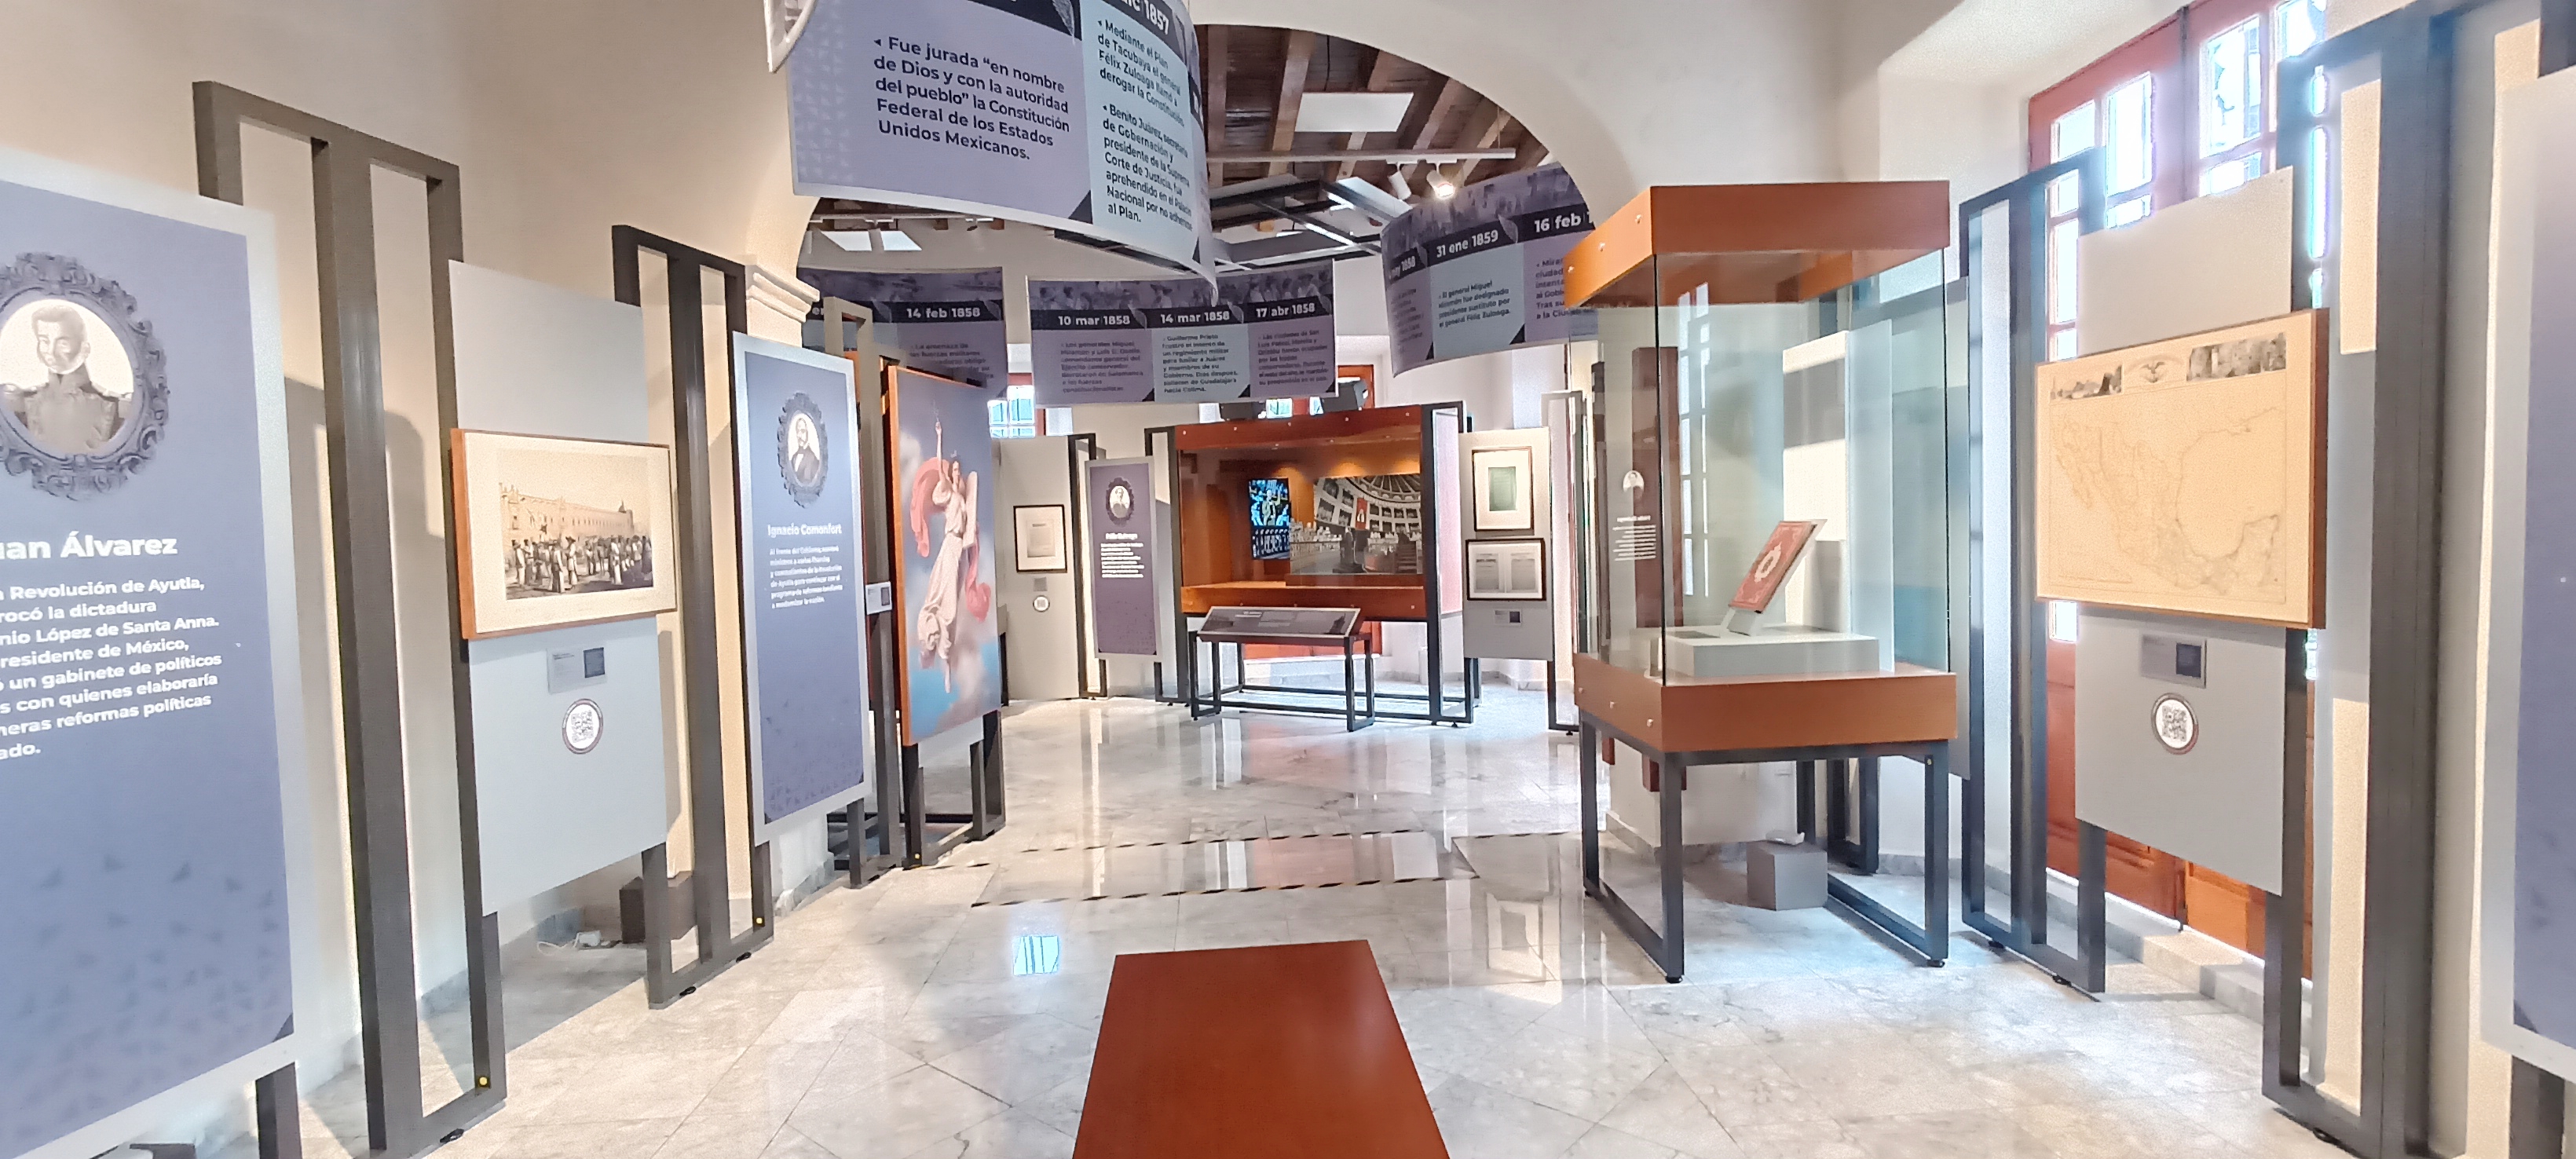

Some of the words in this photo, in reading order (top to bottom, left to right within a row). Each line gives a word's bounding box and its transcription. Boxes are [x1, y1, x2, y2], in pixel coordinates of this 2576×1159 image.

[1143, 0, 1169, 35] 1857
[1098, 33, 1111, 48] de
[1112, 39, 1151, 72] Tacubaya
[1105, 20, 1145, 53] Mediante
[888, 36, 921, 56] Fue
[925, 42, 979, 68] jurada
[982, 57, 1009, 76] “en
[1012, 68, 1065, 93] nombre
[1099, 49, 1121, 70] Félix
[1123, 62, 1154, 90] Zuloaga
[873, 55, 897, 71] de
[902, 60, 939, 79] Dios
[942, 71, 953, 85] y
[957, 75, 986, 90] con
[990, 79, 1002, 93] la
[1006, 86, 1068, 114] autoridad
[1100, 68, 1135, 93] derogar
[1138, 86, 1144, 100] la
[876, 77, 902, 93] del
[906, 83, 968, 104] pueblo”
[973, 94, 986, 110] la
[989, 100, 1070, 132] Constitución
[876, 98, 942, 122] Federal
[948, 111, 968, 126] de
[973, 115, 994, 132] los
[999, 121, 1053, 146] Estados
[1103, 118, 1115, 132] de
[1118, 124, 1169, 159] Gobernación
[1110, 103, 1137, 126] Benito
[1139, 117, 1162, 142] Juárez,
[878, 119, 941, 141] Unidos
[945, 130, 1030, 159] Mexicanos.
[1104, 137, 1149, 163] presidente
[1151, 155, 1159, 169] de
[1161, 159, 1166, 172] la
[1105, 152, 1131, 170] Corte
[1132, 163, 1143, 176] de
[1144, 166, 1173, 191] Justicia,
[1107, 170, 1158, 199] aprehendido
[1107, 185, 1144, 207] Nacional
[1147, 201, 1158, 214] por
[1160, 207, 1169, 218] no
[1108, 203, 1117, 214] al
[1119, 205, 1141, 222] Plan.
[1535, 218, 1550, 233] 16
[1555, 213, 1582, 229] feb
[1436, 244, 1446, 258] 31
[1449, 239, 1469, 254] ene
[1472, 229, 1498, 247] 1859
[906, 307, 921, 318] 14
[926, 307, 947, 318] feb
[951, 307, 981, 318] 1858
[1058, 316, 1071, 326] 10
[1076, 317, 1100, 326] mar
[1103, 315, 1131, 326] 1858
[1161, 313, 1173, 324] 14
[1178, 314, 1201, 323] mar
[1204, 311, 1230, 322] 1858
[1256, 307, 1268, 318] 17
[1272, 305, 1290, 316] abr
[0, 540, 52, 560] an
[60, 530, 178, 558] Álvarez
[768, 522, 800, 539] Ignacio
[800, 522, 843, 536] Comonfort
[9, 581, 118, 601] Revolución
[121, 580, 146, 594] de
[148, 576, 205, 594] Ayutla,
[48, 605, 65, 620] la
[69, 601, 157, 618] dictadura
[35, 627, 93, 644] López
[95, 623, 119, 637] de
[122, 620, 171, 634] Santa
[174, 616, 220, 631] Anna.
[97, 644, 122, 658] de
[126, 638, 189, 656] México,
[9, 676, 37, 689] un
[41, 667, 126, 689] gabinete
[128, 662, 152, 675] de
[155, 654, 222, 675] políticos
[16, 696, 55, 711] con
[59, 686, 134, 708] quienes
[136, 673, 218, 695] elaboraría
[56, 704, 140, 729] reformas
[143, 695, 212, 718] políticas
